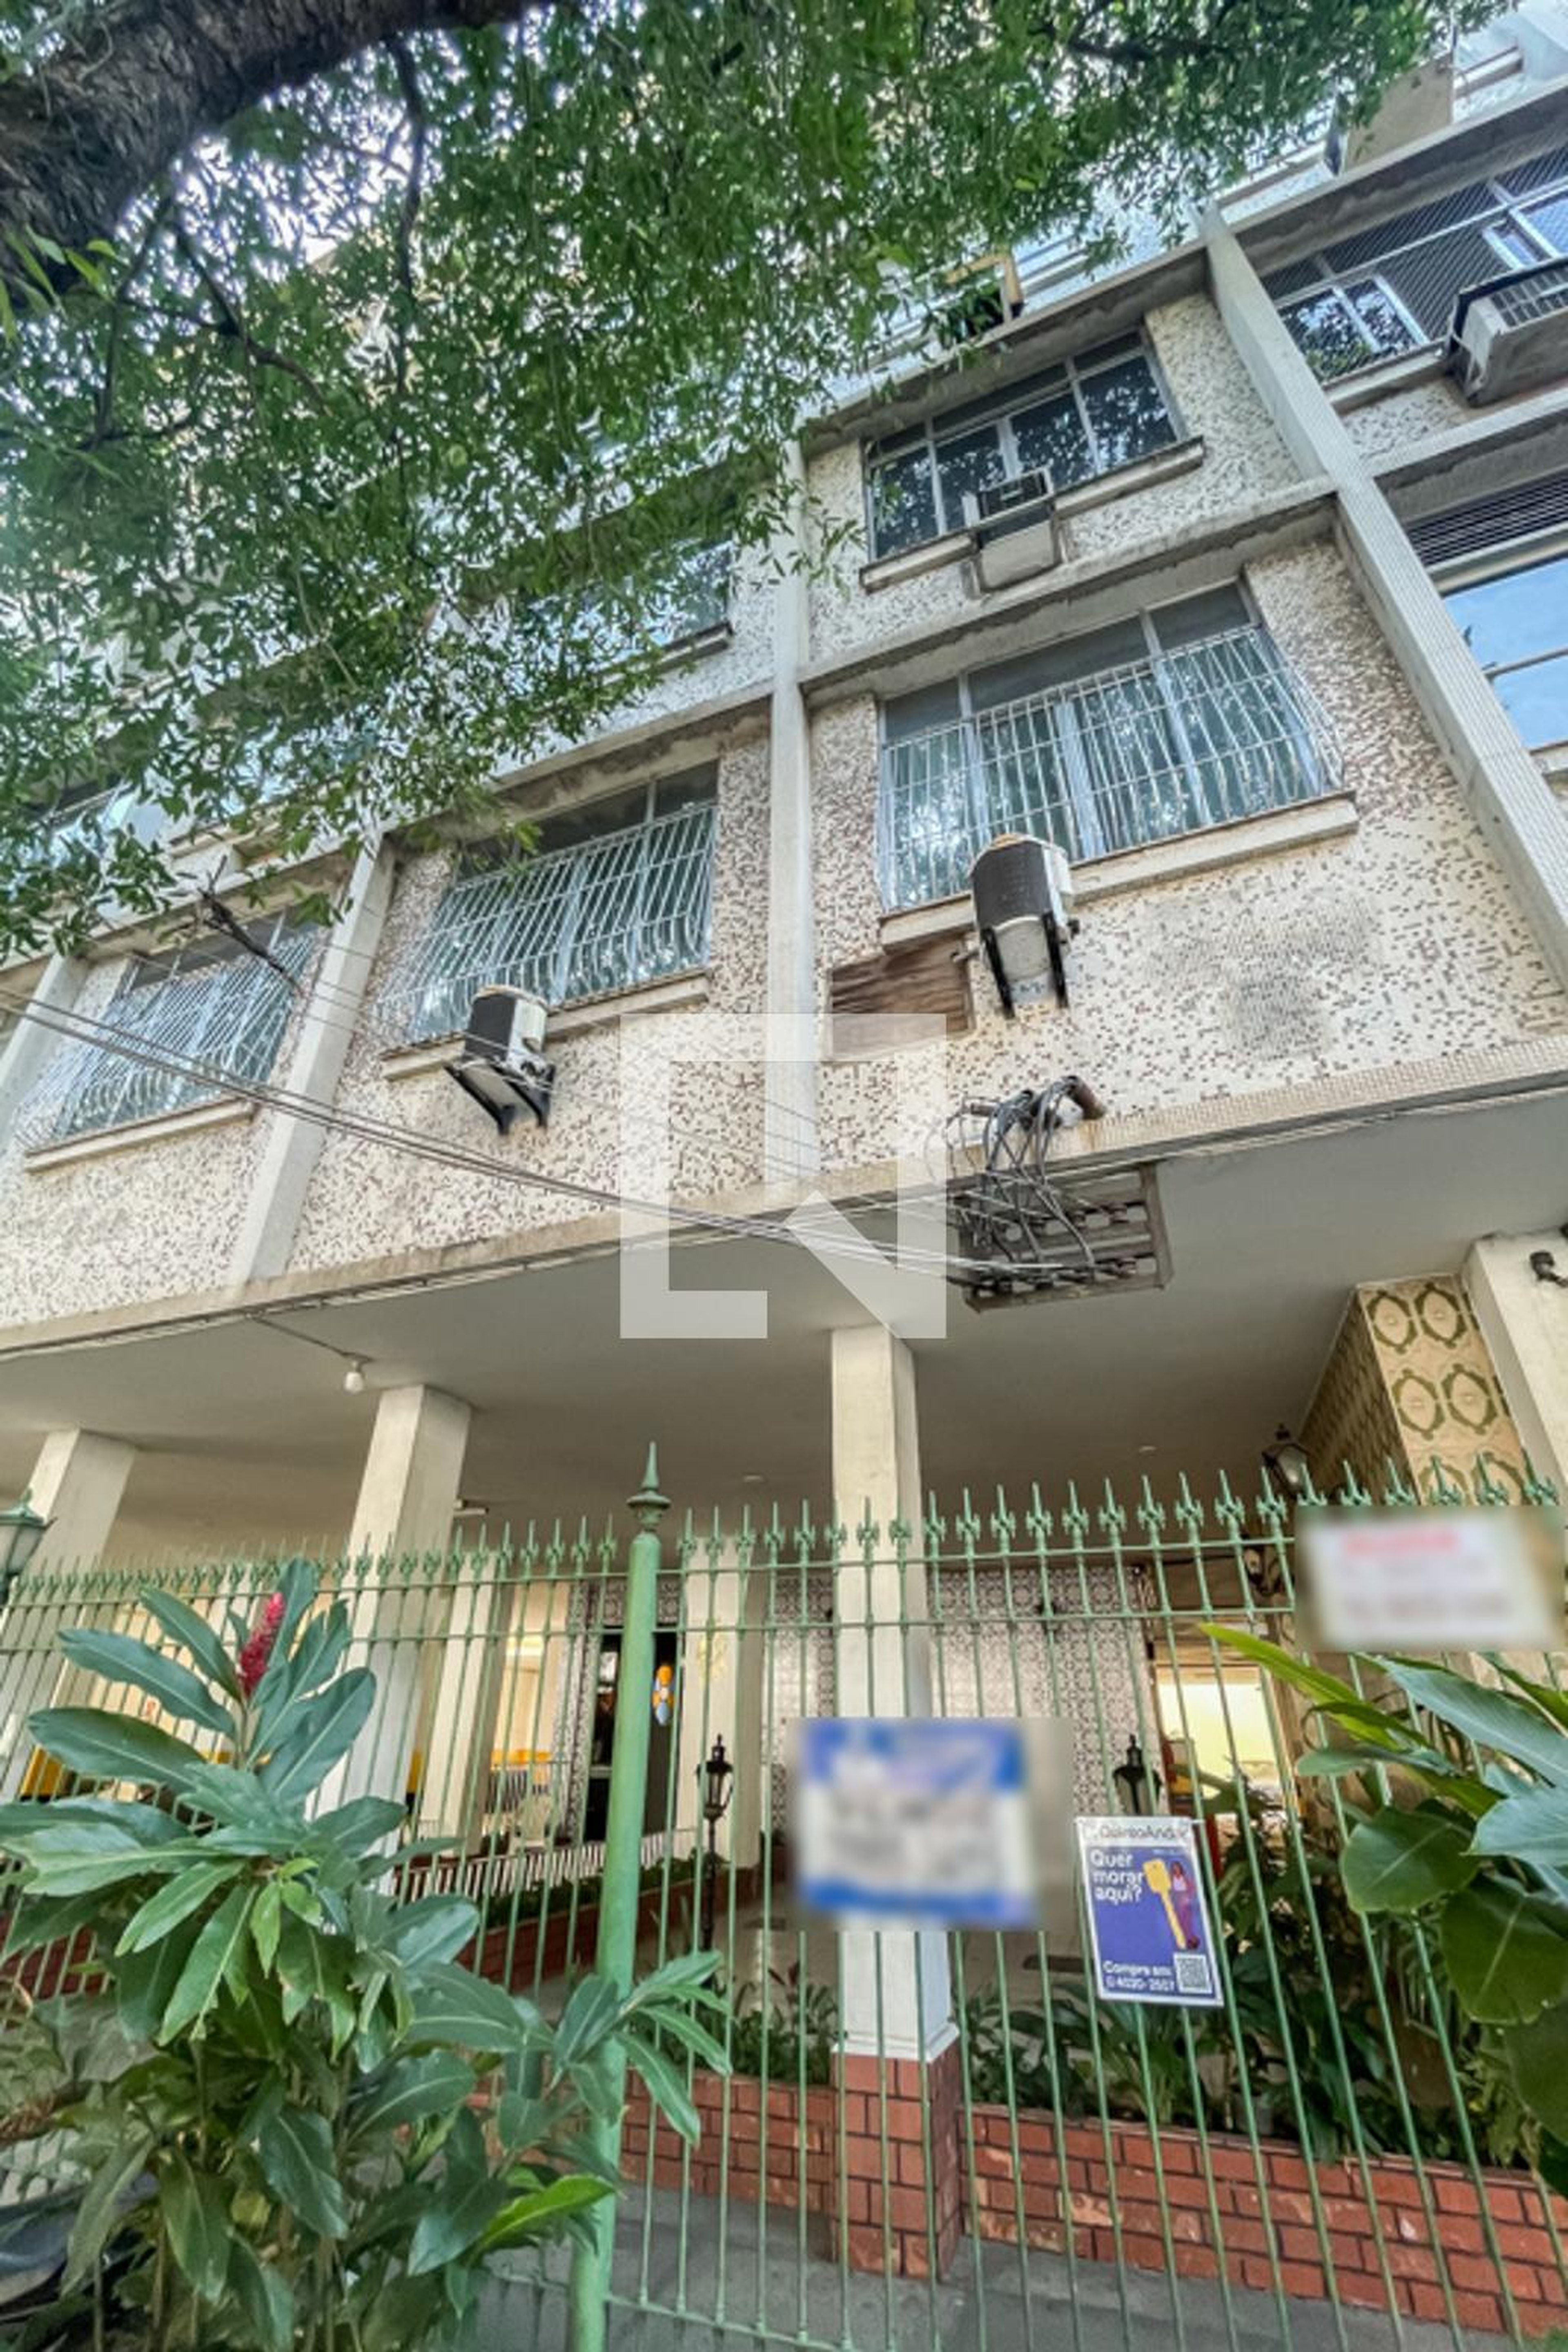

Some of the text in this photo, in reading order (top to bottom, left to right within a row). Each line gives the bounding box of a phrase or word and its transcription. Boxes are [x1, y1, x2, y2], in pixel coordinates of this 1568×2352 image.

[1090, 1849, 1133, 1867] Quer
[1092, 1870, 1144, 1885] morar
[1095, 1884, 1142, 1906] aqui?
